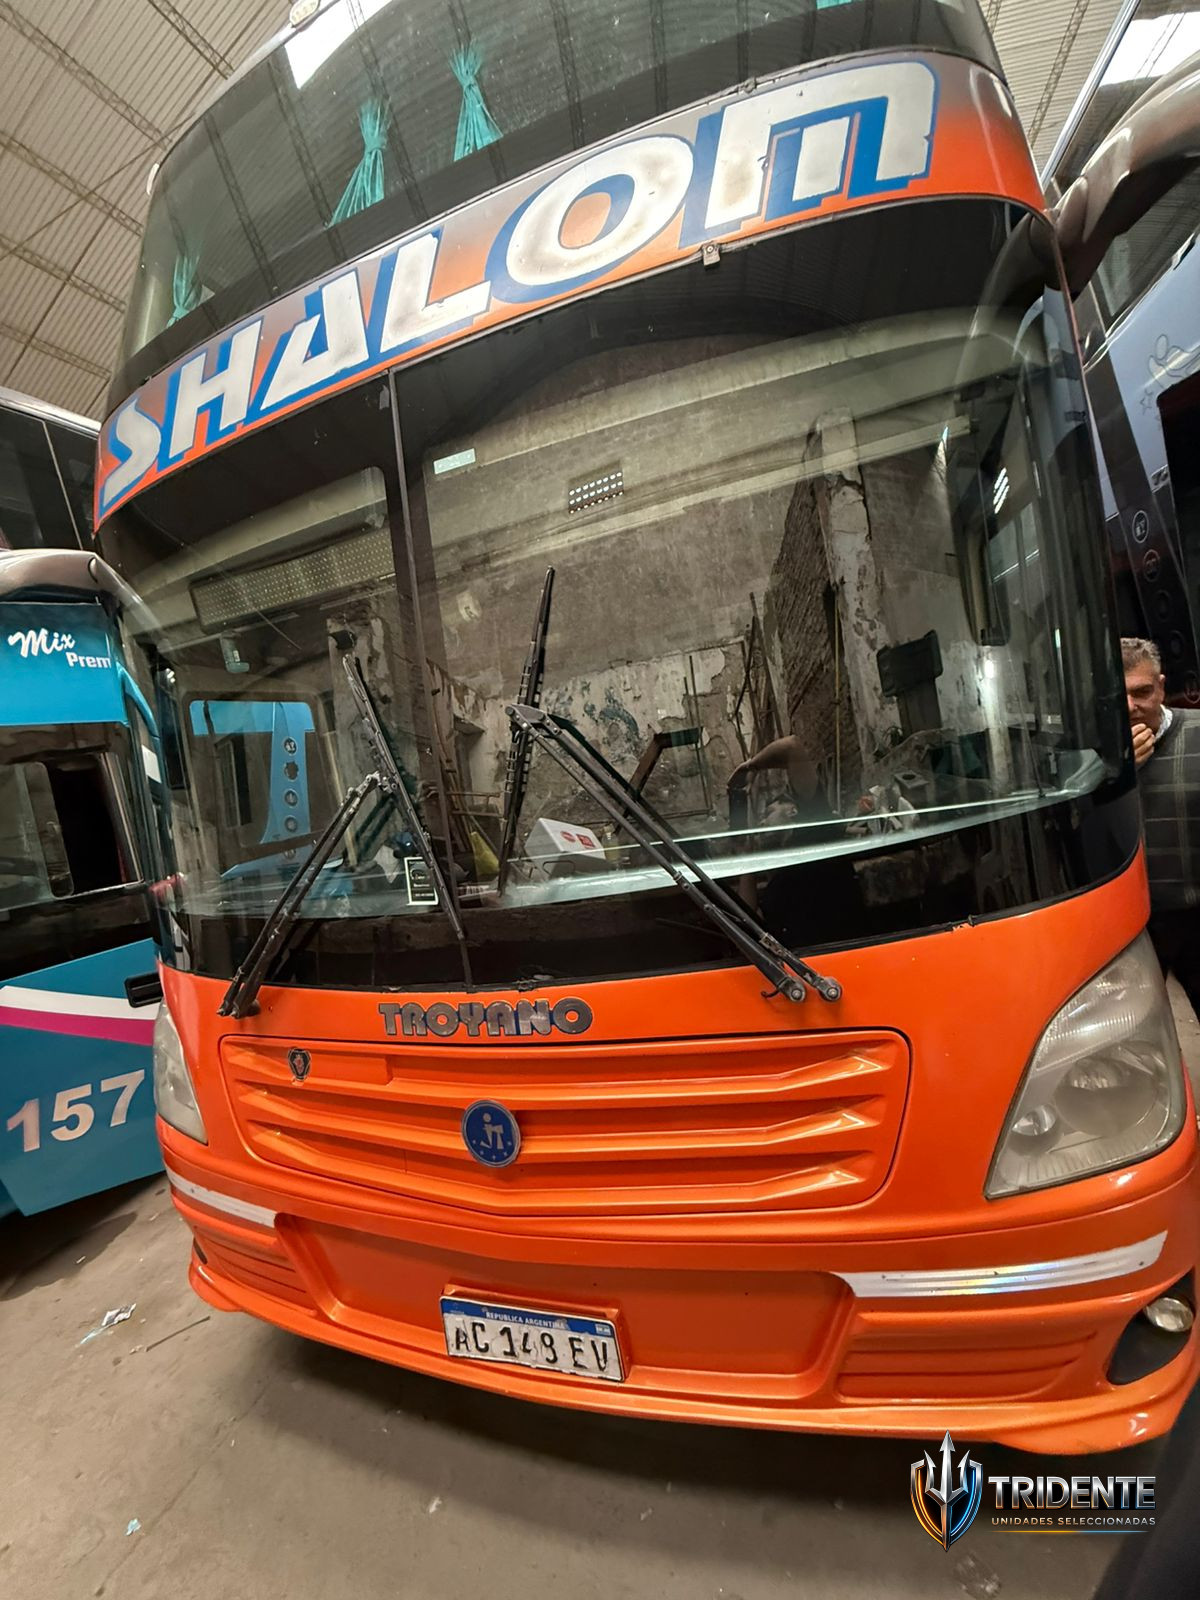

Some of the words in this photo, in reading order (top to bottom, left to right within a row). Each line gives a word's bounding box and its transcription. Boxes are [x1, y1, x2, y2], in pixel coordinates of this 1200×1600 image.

[8, 628, 75, 658] Mix
[378, 998, 593, 1037] TROYANO
[7, 1069, 145, 1152] 157
[455, 1322, 489, 1353] AC
[568, 1336, 608, 1371] EV
